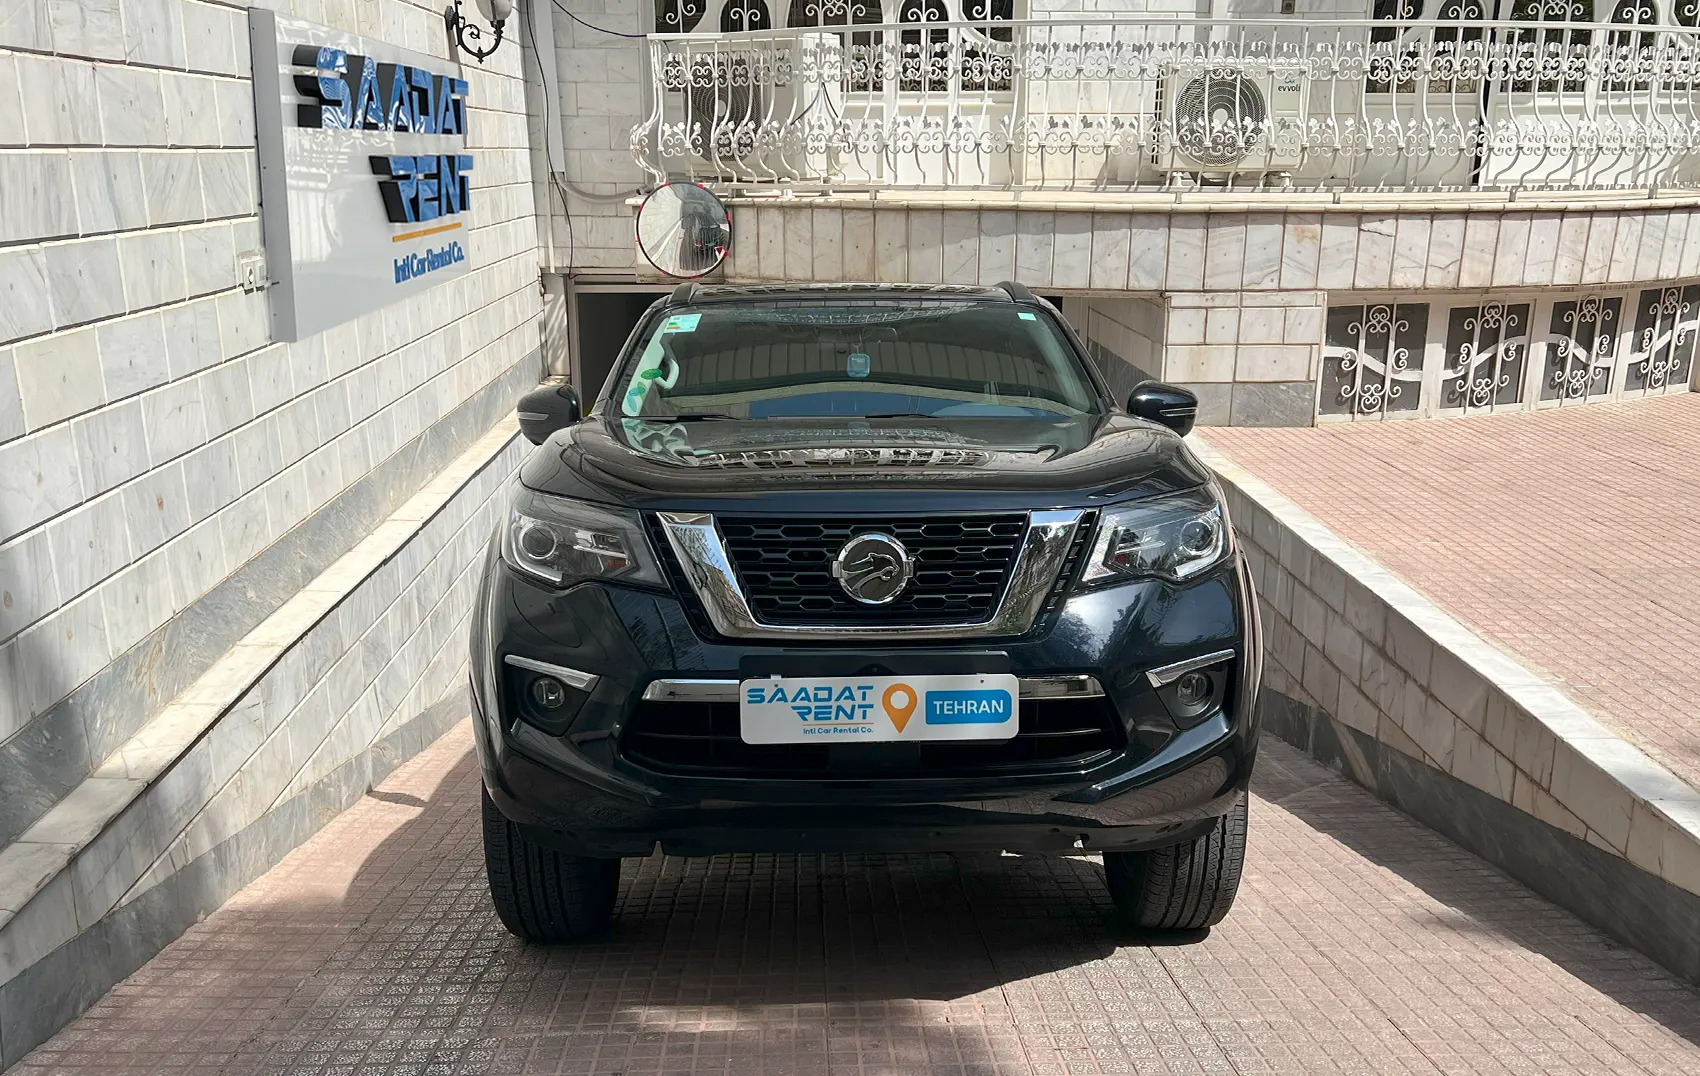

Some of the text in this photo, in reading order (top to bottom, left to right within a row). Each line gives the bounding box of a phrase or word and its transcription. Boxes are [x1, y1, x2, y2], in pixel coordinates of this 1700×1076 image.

[312, 46, 469, 135] SAADAT
[384, 155, 473, 223] RENT
[410, 252, 426, 278] Car
[426, 242, 452, 272] Rental
[747, 685, 874, 704] SAADAT
[790, 704, 874, 721] RENT
[933, 699, 1004, 715] TEHRAN
[817, 727, 832, 735] Car
[833, 726, 860, 734] Rental
